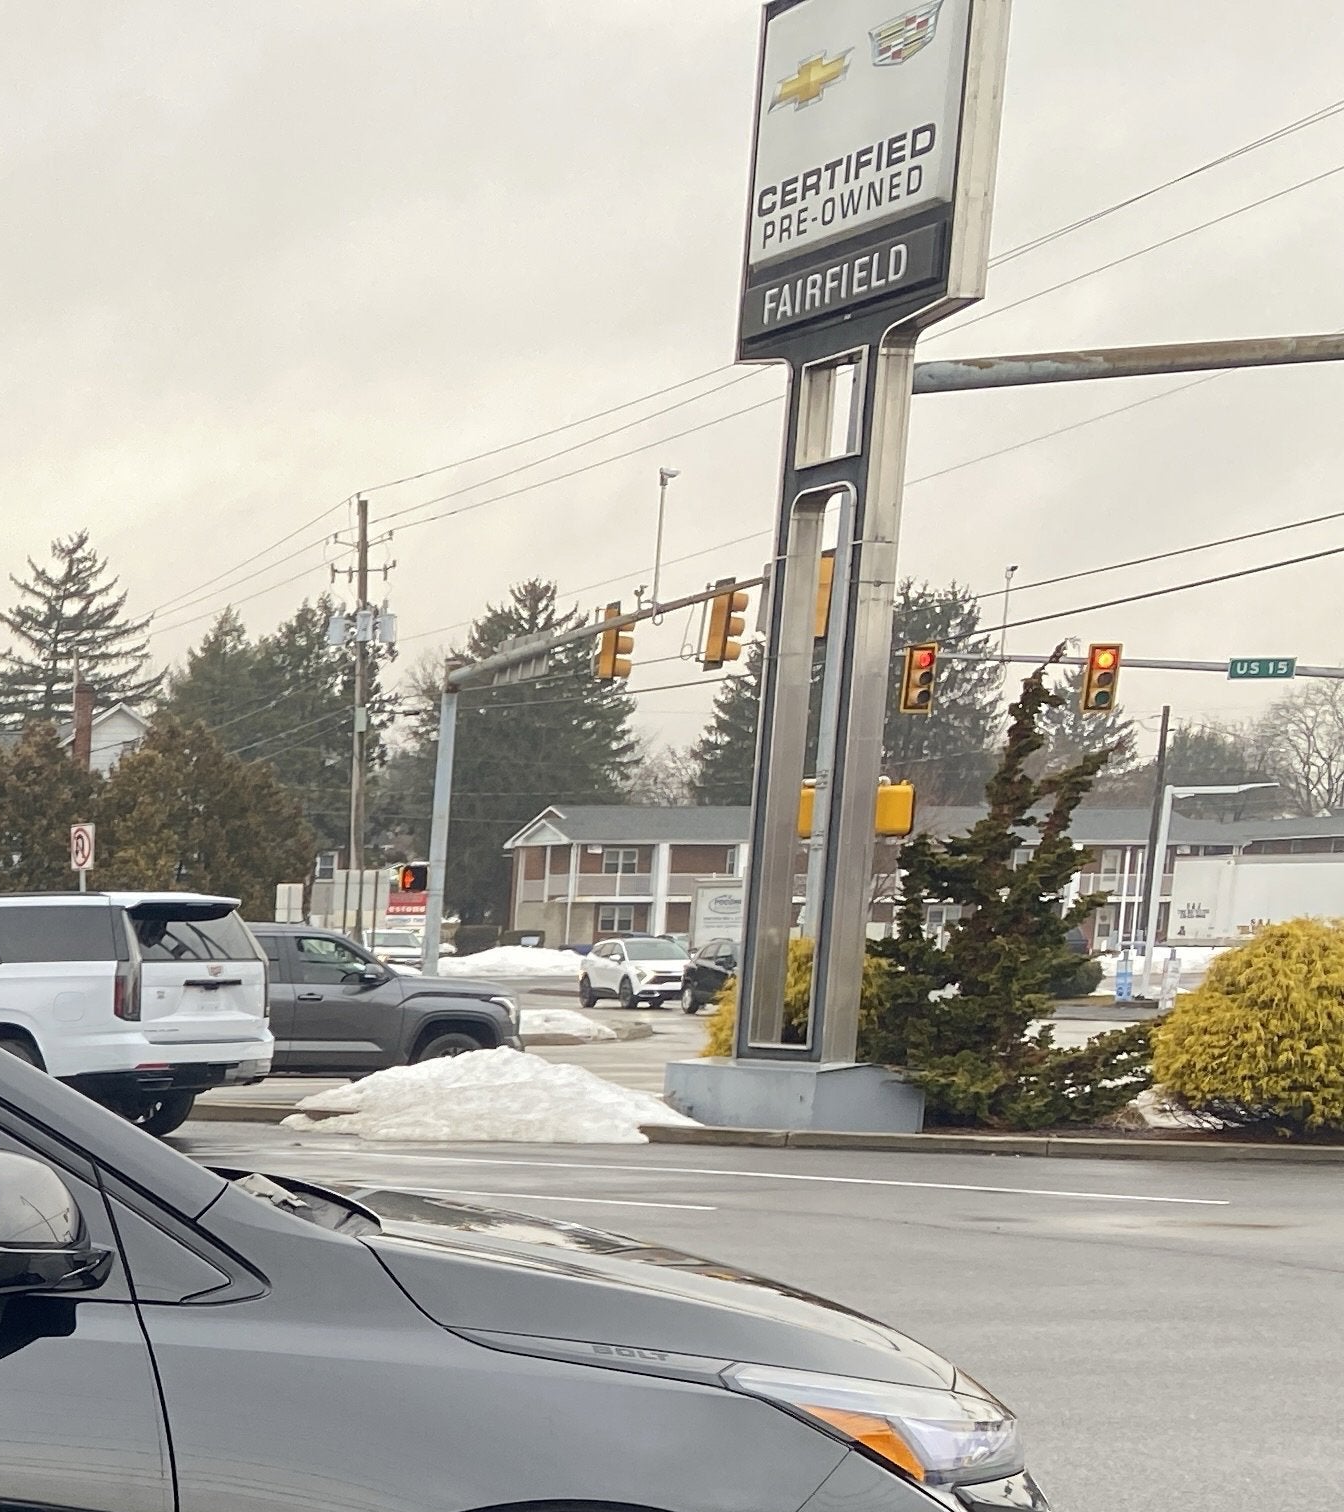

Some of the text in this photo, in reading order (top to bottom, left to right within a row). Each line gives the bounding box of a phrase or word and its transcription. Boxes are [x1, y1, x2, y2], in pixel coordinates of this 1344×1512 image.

[757, 122, 936, 218] CERTIFIED
[762, 164, 924, 250] PRE-OWNED
[762, 243, 909, 326] FAIRFIELD
[1236, 661, 1288, 675] US 15
[591, 1345, 670, 1361] BOLT
